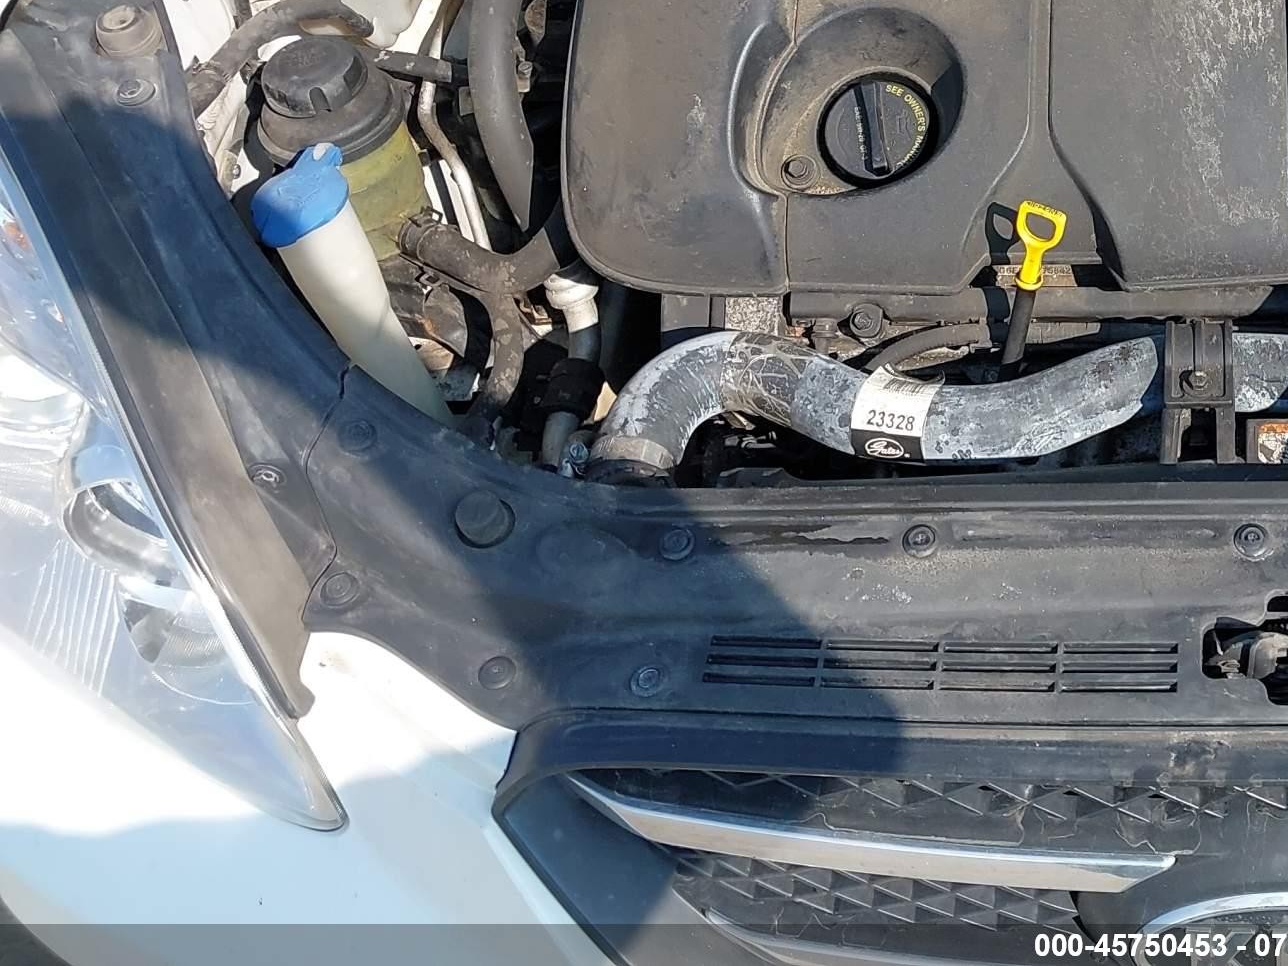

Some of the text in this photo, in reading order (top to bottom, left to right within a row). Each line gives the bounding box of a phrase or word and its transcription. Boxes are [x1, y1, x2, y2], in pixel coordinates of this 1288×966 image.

[885, 84, 904, 96] SEE
[904, 94, 926, 132] OWNER'S
[866, 409, 916, 432] 23328
